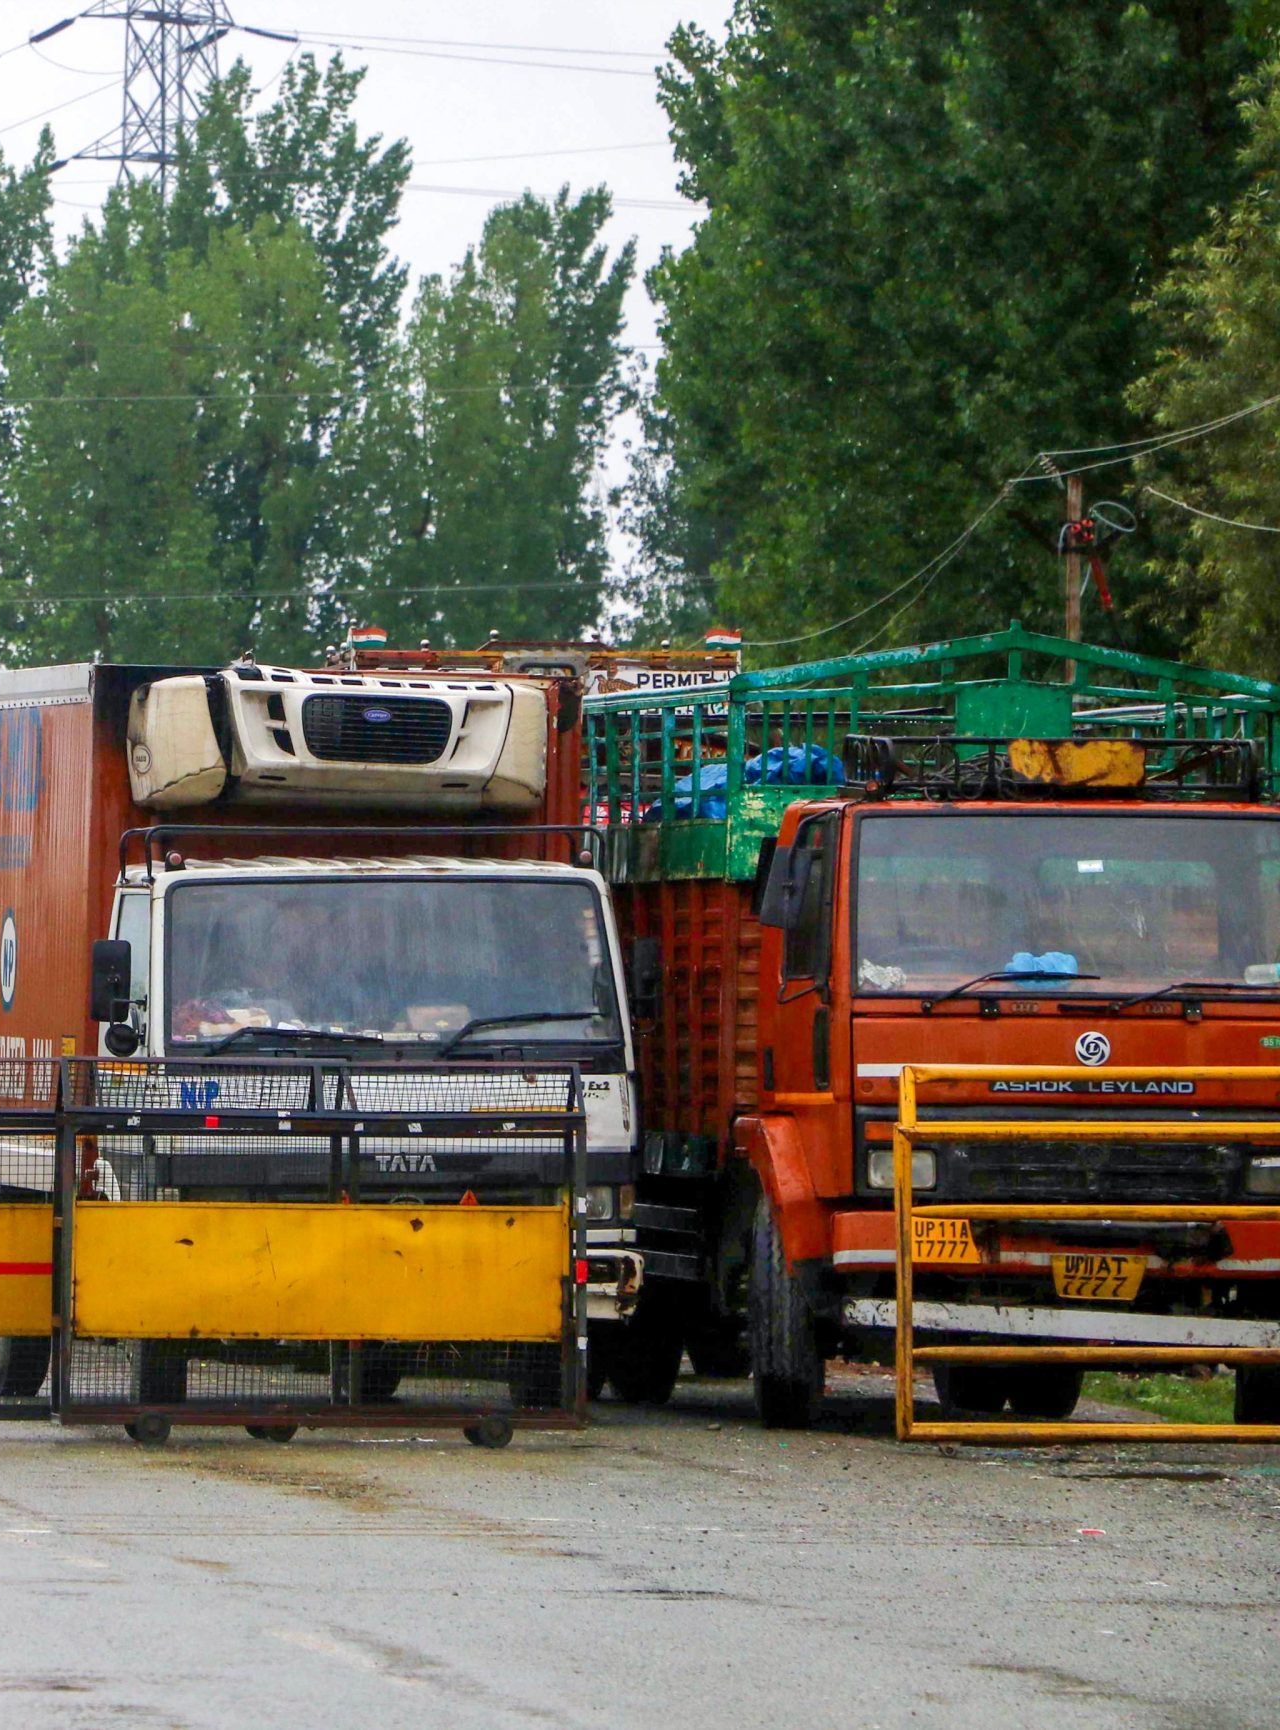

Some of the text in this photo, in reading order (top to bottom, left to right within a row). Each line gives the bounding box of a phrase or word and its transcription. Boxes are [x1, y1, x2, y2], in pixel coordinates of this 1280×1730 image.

[636, 671, 710, 690] PERMIT
[32, 1038, 53, 1101] VAN
[992, 1080, 1195, 1094] ASHOK LEYLAND
[375, 1155, 438, 1173] TATA
[915, 1240, 969, 1258] T7777
[1062, 1275, 1128, 1297] 7777
